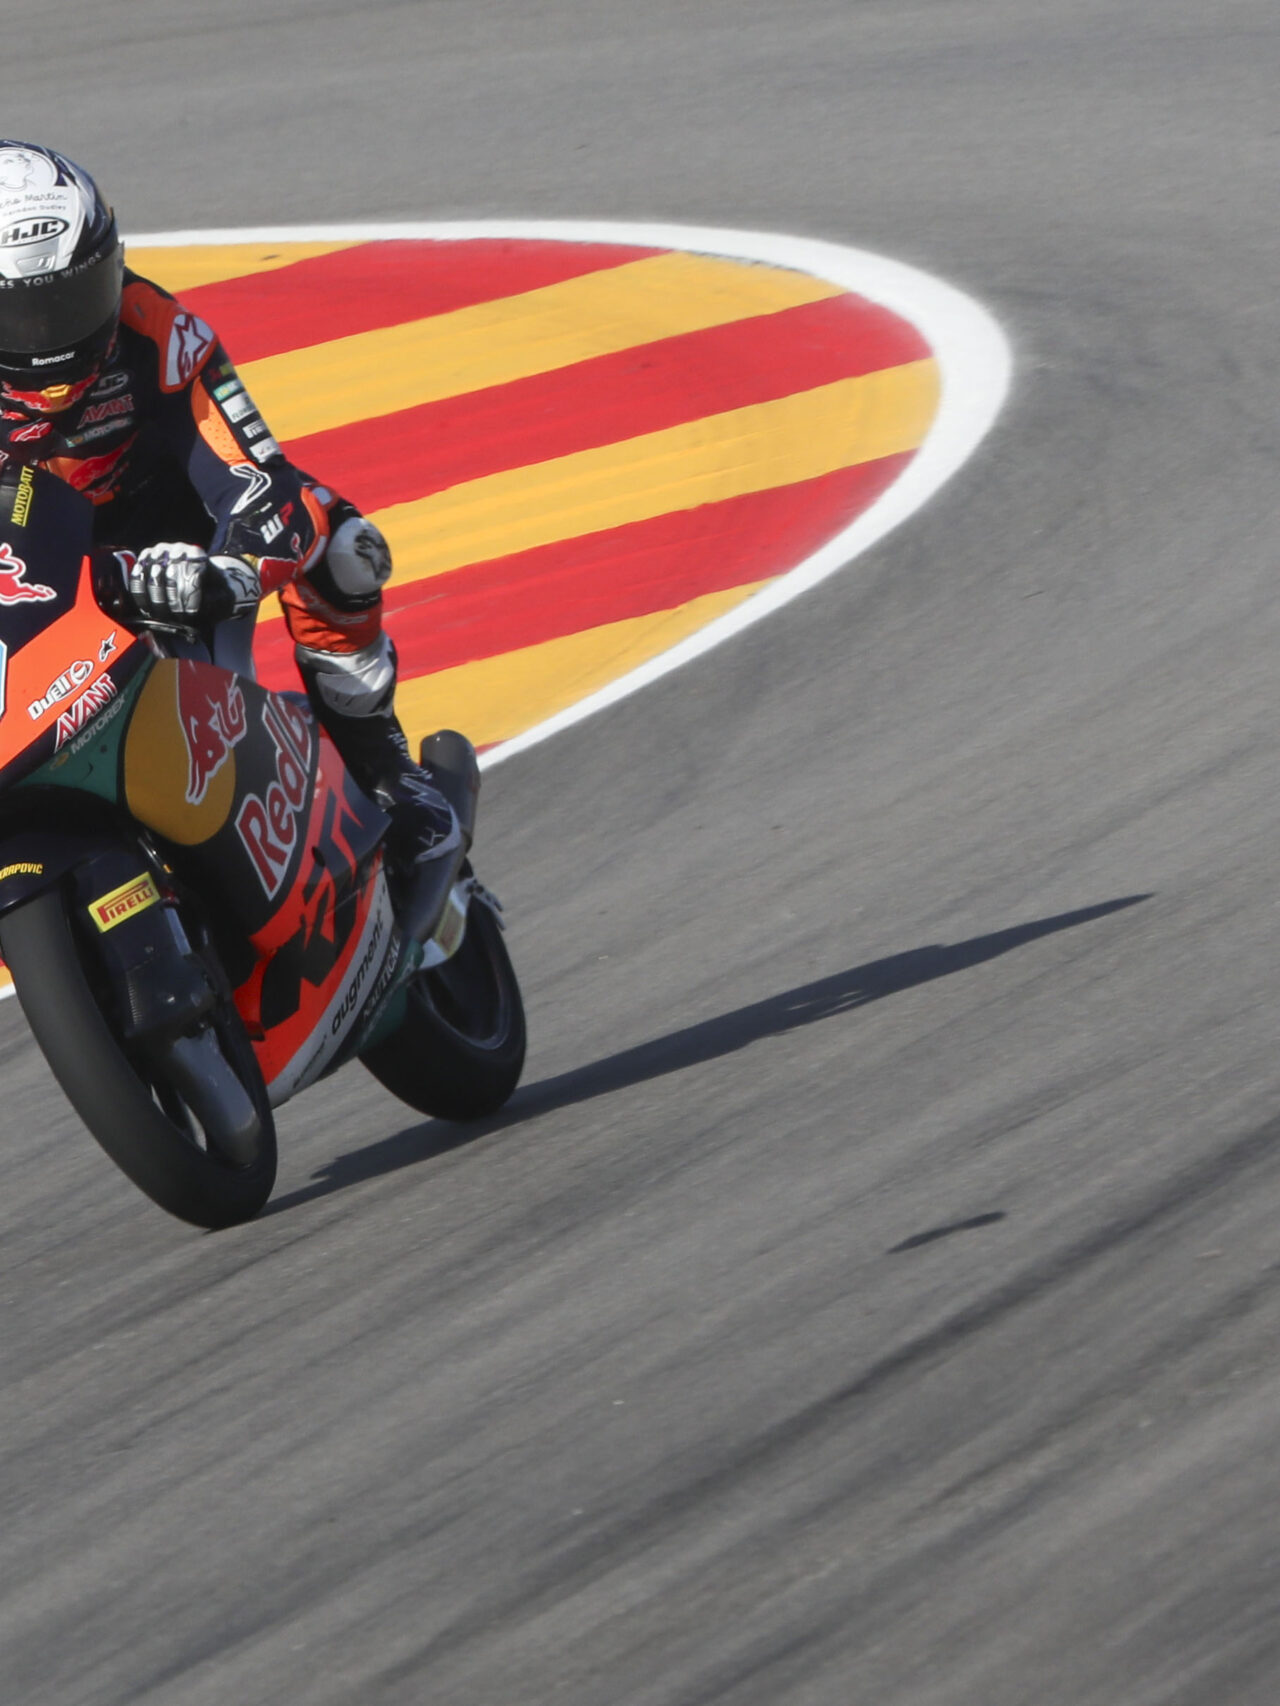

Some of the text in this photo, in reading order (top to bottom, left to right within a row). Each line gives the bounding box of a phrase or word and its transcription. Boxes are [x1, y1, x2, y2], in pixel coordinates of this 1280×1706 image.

[0, 220, 58, 245] HJC
[23, 275, 54, 287] YOU
[61, 251, 102, 279] WINGS
[31, 351, 75, 366] Romacar
[77, 394, 135, 430] AVANT
[11, 465, 35, 527] MOTOBATT
[53, 672, 118, 754] AVANT
[70, 694, 126, 754] MOTOREX
[97, 879, 154, 924] PIRELLI
[331, 906, 384, 1036] augment
